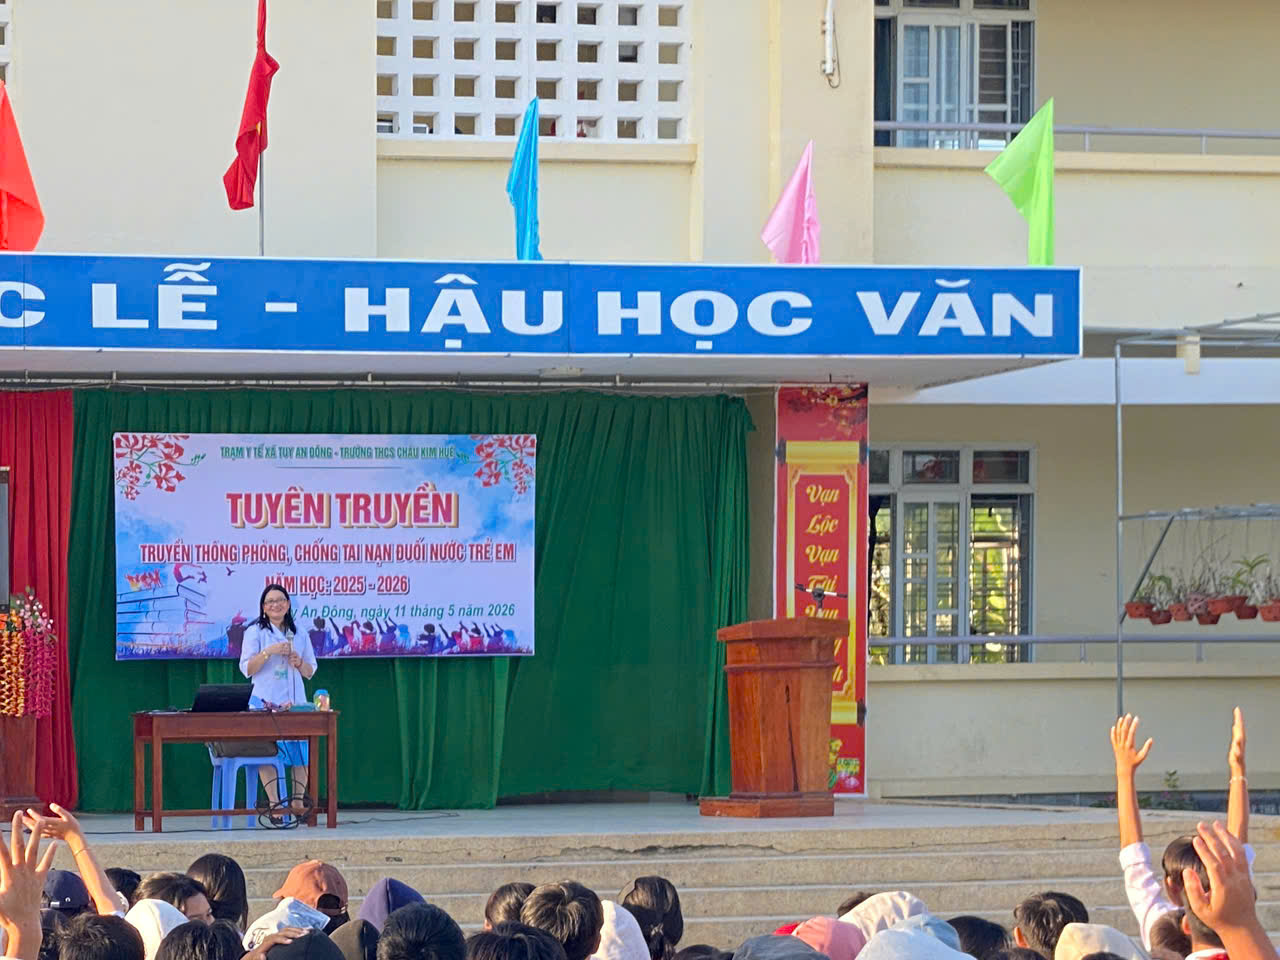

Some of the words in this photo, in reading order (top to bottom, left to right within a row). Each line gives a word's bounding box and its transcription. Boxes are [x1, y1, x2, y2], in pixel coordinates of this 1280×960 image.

[92, 262, 218, 330] LỄ
[266, 303, 297, 312] -
[344, 273, 563, 348] HẬU
[598, 291, 812, 349] HỌC
[857, 279, 1053, 337] VĂN
[375, 447, 395, 459] THCS
[421, 447, 437, 459] KIM
[226, 485, 331, 528] TUYÊN
[335, 483, 459, 528] TRUYỀN
[806, 484, 840, 506] Vạn
[806, 514, 839, 536] Lộc
[195, 540, 239, 563] THÔNG
[242, 539, 292, 566] PHÒNG,
[294, 537, 340, 563] CHỐNG
[343, 543, 362, 562] TAI
[365, 543, 393, 567] NẠN
[396, 537, 428, 563] ĐUỐI
[430, 538, 467, 563] NƯỚC
[469, 537, 493, 563] TRẺ
[495, 543, 516, 562] EM
[805, 545, 839, 566] Vạn
[299, 576, 331, 599] HỌC:
[333, 576, 366, 594] 2025
[377, 575, 410, 594] 2026
[301, 606, 317, 618] An
[321, 605, 357, 621] Đông,
[360, 604, 391, 621] ngày
[394, 603, 406, 616] 11
[410, 603, 444, 620] tháng
[448, 604, 455, 616] 5
[458, 603, 484, 617] năm
[488, 603, 515, 616] 2026
